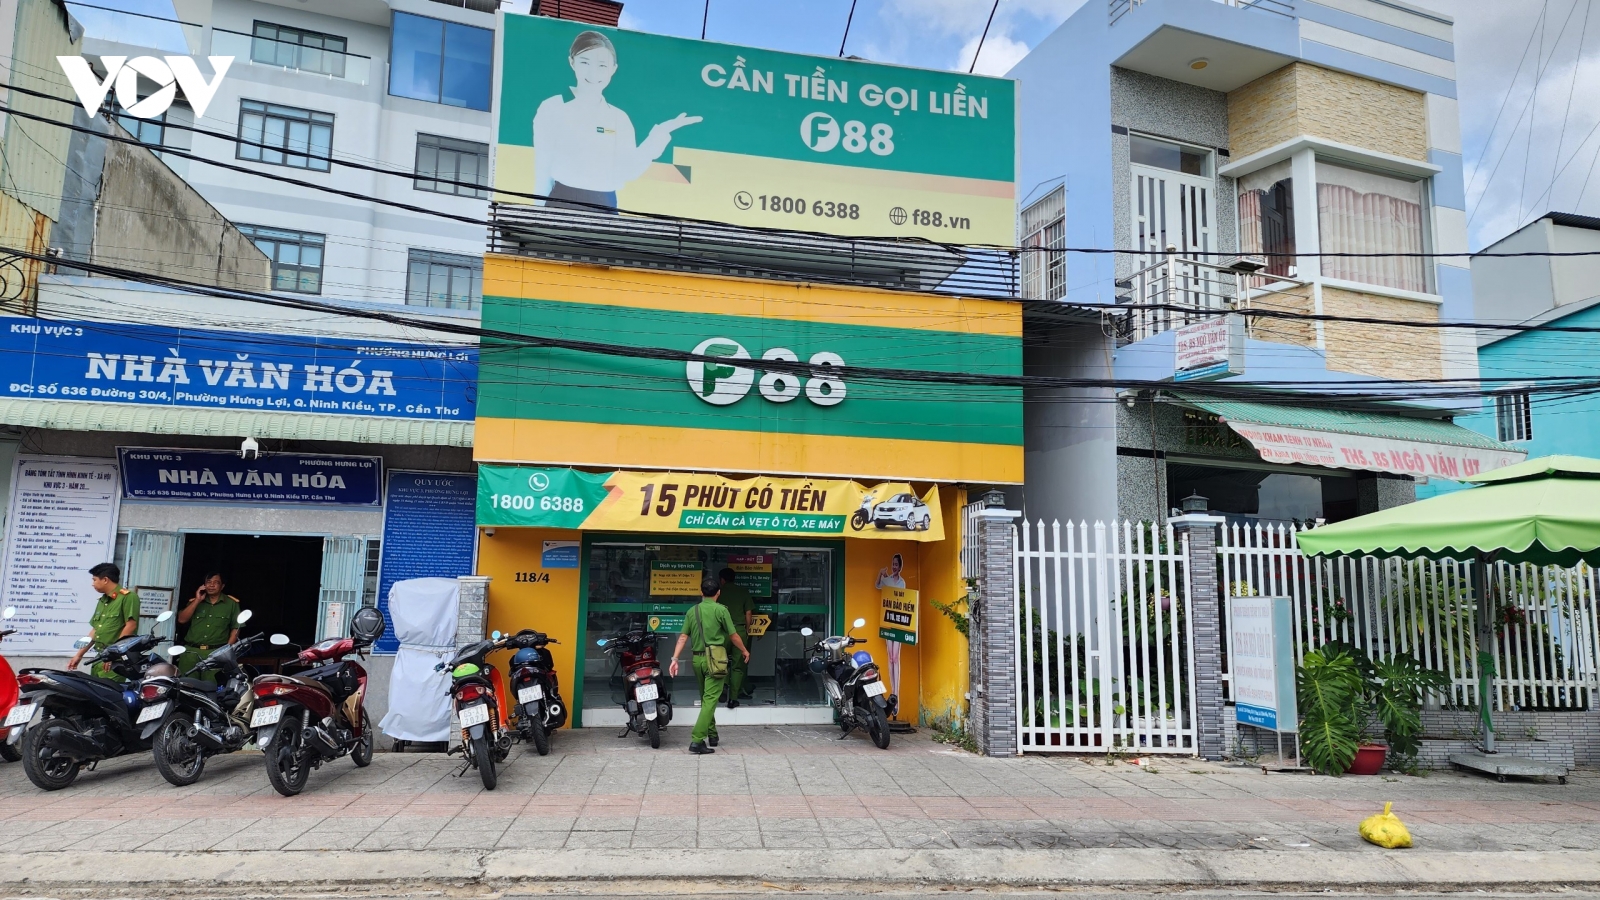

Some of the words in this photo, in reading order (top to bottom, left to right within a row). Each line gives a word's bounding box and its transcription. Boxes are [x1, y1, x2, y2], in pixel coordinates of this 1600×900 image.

[701, 55, 774, 94] CẦN
[784, 65, 848, 104] TIỀN
[859, 84, 918, 116] GỌI
[929, 82, 988, 119] LIỀN
[800, 111, 895, 156] F88
[758, 195, 807, 215] 1800
[812, 200, 860, 220] 6388
[912, 209, 971, 230] f88.vn
[11, 324, 41, 334] KHU
[44, 325, 72, 338] VỰC
[74, 327, 83, 336] 3
[85, 348, 190, 384] NHÀ
[199, 353, 293, 390] VĂN
[303, 360, 396, 396] HÓA
[686, 337, 847, 406] F88
[9, 383, 35, 393] ĐC:
[61, 386, 88, 396] 636
[91, 387, 136, 400] Đường
[138, 390, 172, 402] 30/4,
[176, 392, 226, 405] Phường
[230, 394, 264, 407] Hưng
[267, 397, 291, 409] Lợi,
[293, 398, 307, 408] Q.
[309, 399, 339, 409] Ninh
[405, 403, 431, 415] Cần
[435, 405, 460, 416] Thơ
[300, 459, 333, 467] PHƯỜNG
[1340, 447, 1372, 467] THS.
[1372, 451, 1390, 468] BS
[1389, 448, 1425, 473] NGÔ
[1425, 451, 1459, 477] VĂN
[1462, 454, 1480, 477] ÚT
[158, 467, 218, 485] NHÀ
[226, 469, 282, 486] VĂN
[292, 471, 346, 489] HÓA
[490, 494, 534, 511] 1800
[540, 495, 584, 513] 6388
[639, 483, 679, 517] 15
[683, 482, 742, 509] PHÚT
[745, 483, 773, 510] CÓ
[780, 482, 827, 512] TIỀN
[685, 513, 706, 525] CHỈ
[732, 515, 746, 527] CÀ
[749, 516, 770, 529] VẸT
[772, 516, 780, 527] Ô
[782, 516, 800, 529] TÔ,
[801, 518, 816, 528] XE
[818, 518, 841, 530] MÁY
[514, 572, 550, 583] 118/4
[465, 714, 484, 725] 2022
